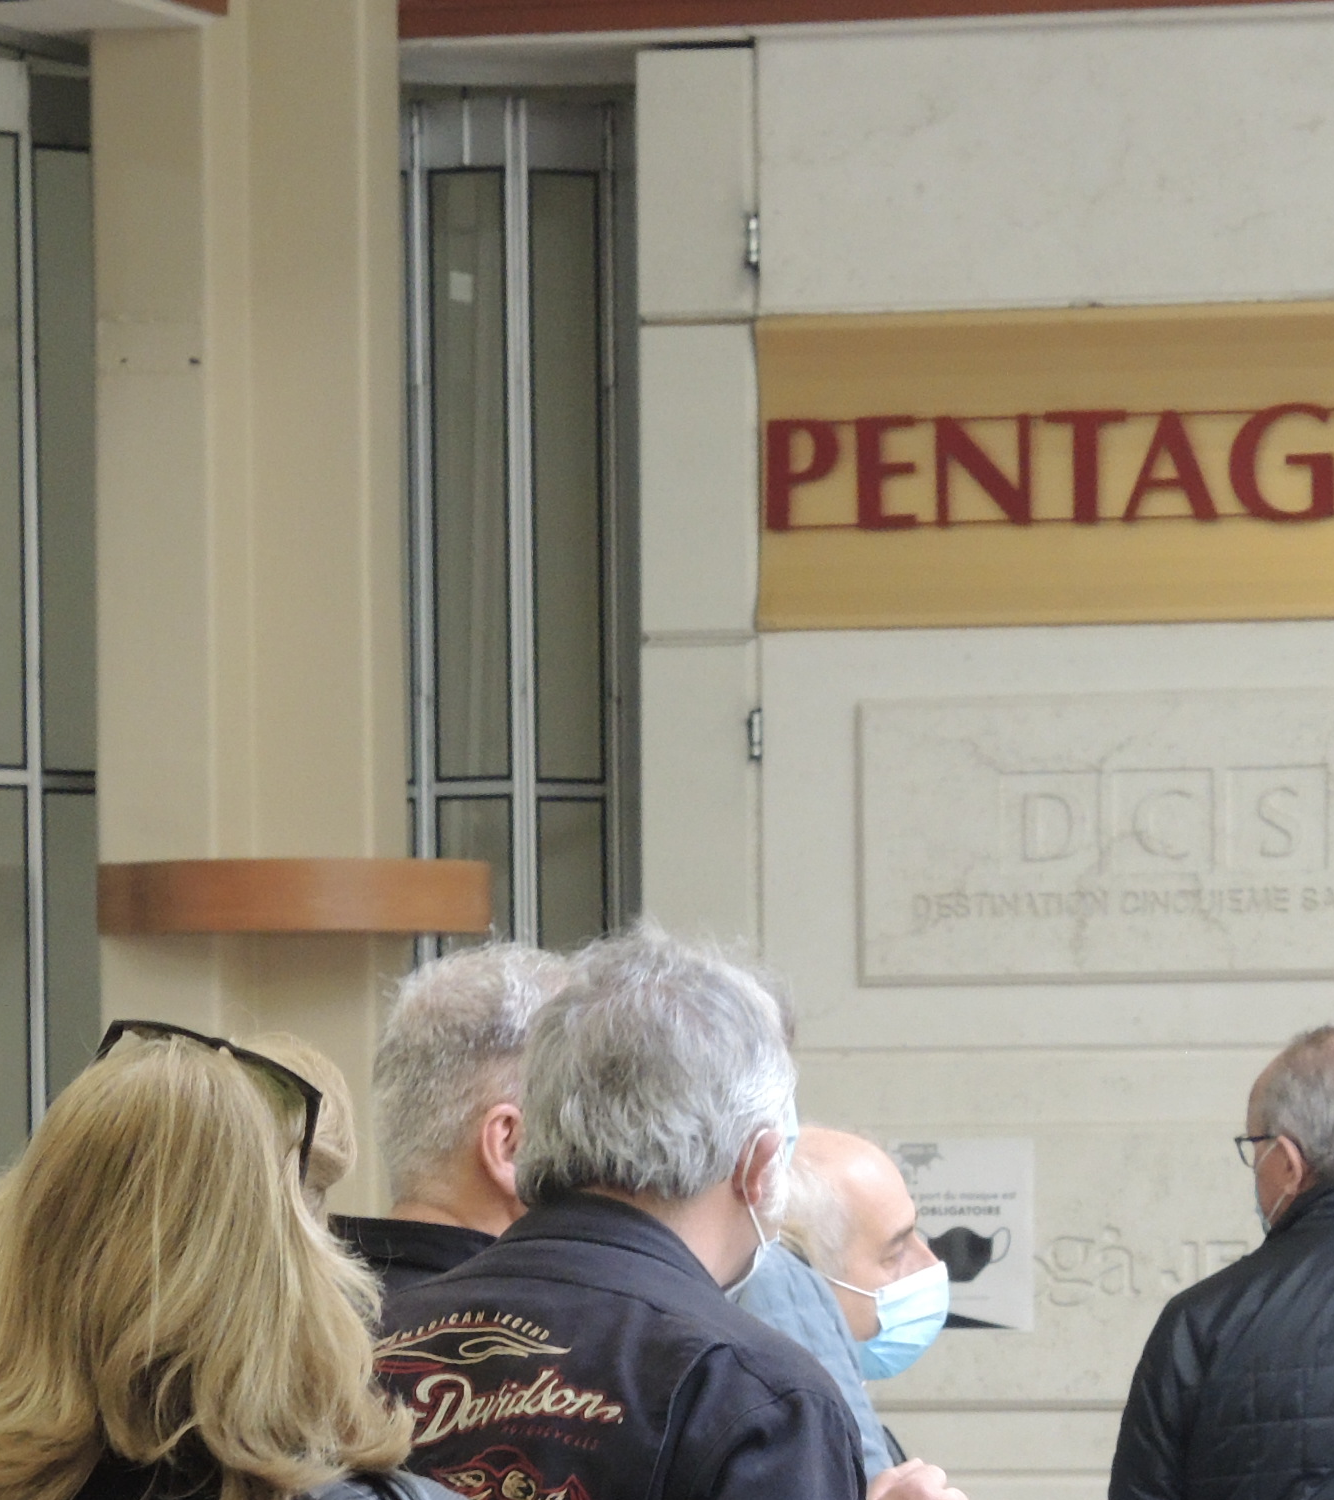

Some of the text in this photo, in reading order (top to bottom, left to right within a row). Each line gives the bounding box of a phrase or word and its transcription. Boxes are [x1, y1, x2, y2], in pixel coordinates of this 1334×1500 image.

[920, 1205, 1001, 1216] OBLIGATOIRE
[494, 1311, 550, 1342] LEGEND
[413, 1368, 624, 1444] Davidson
